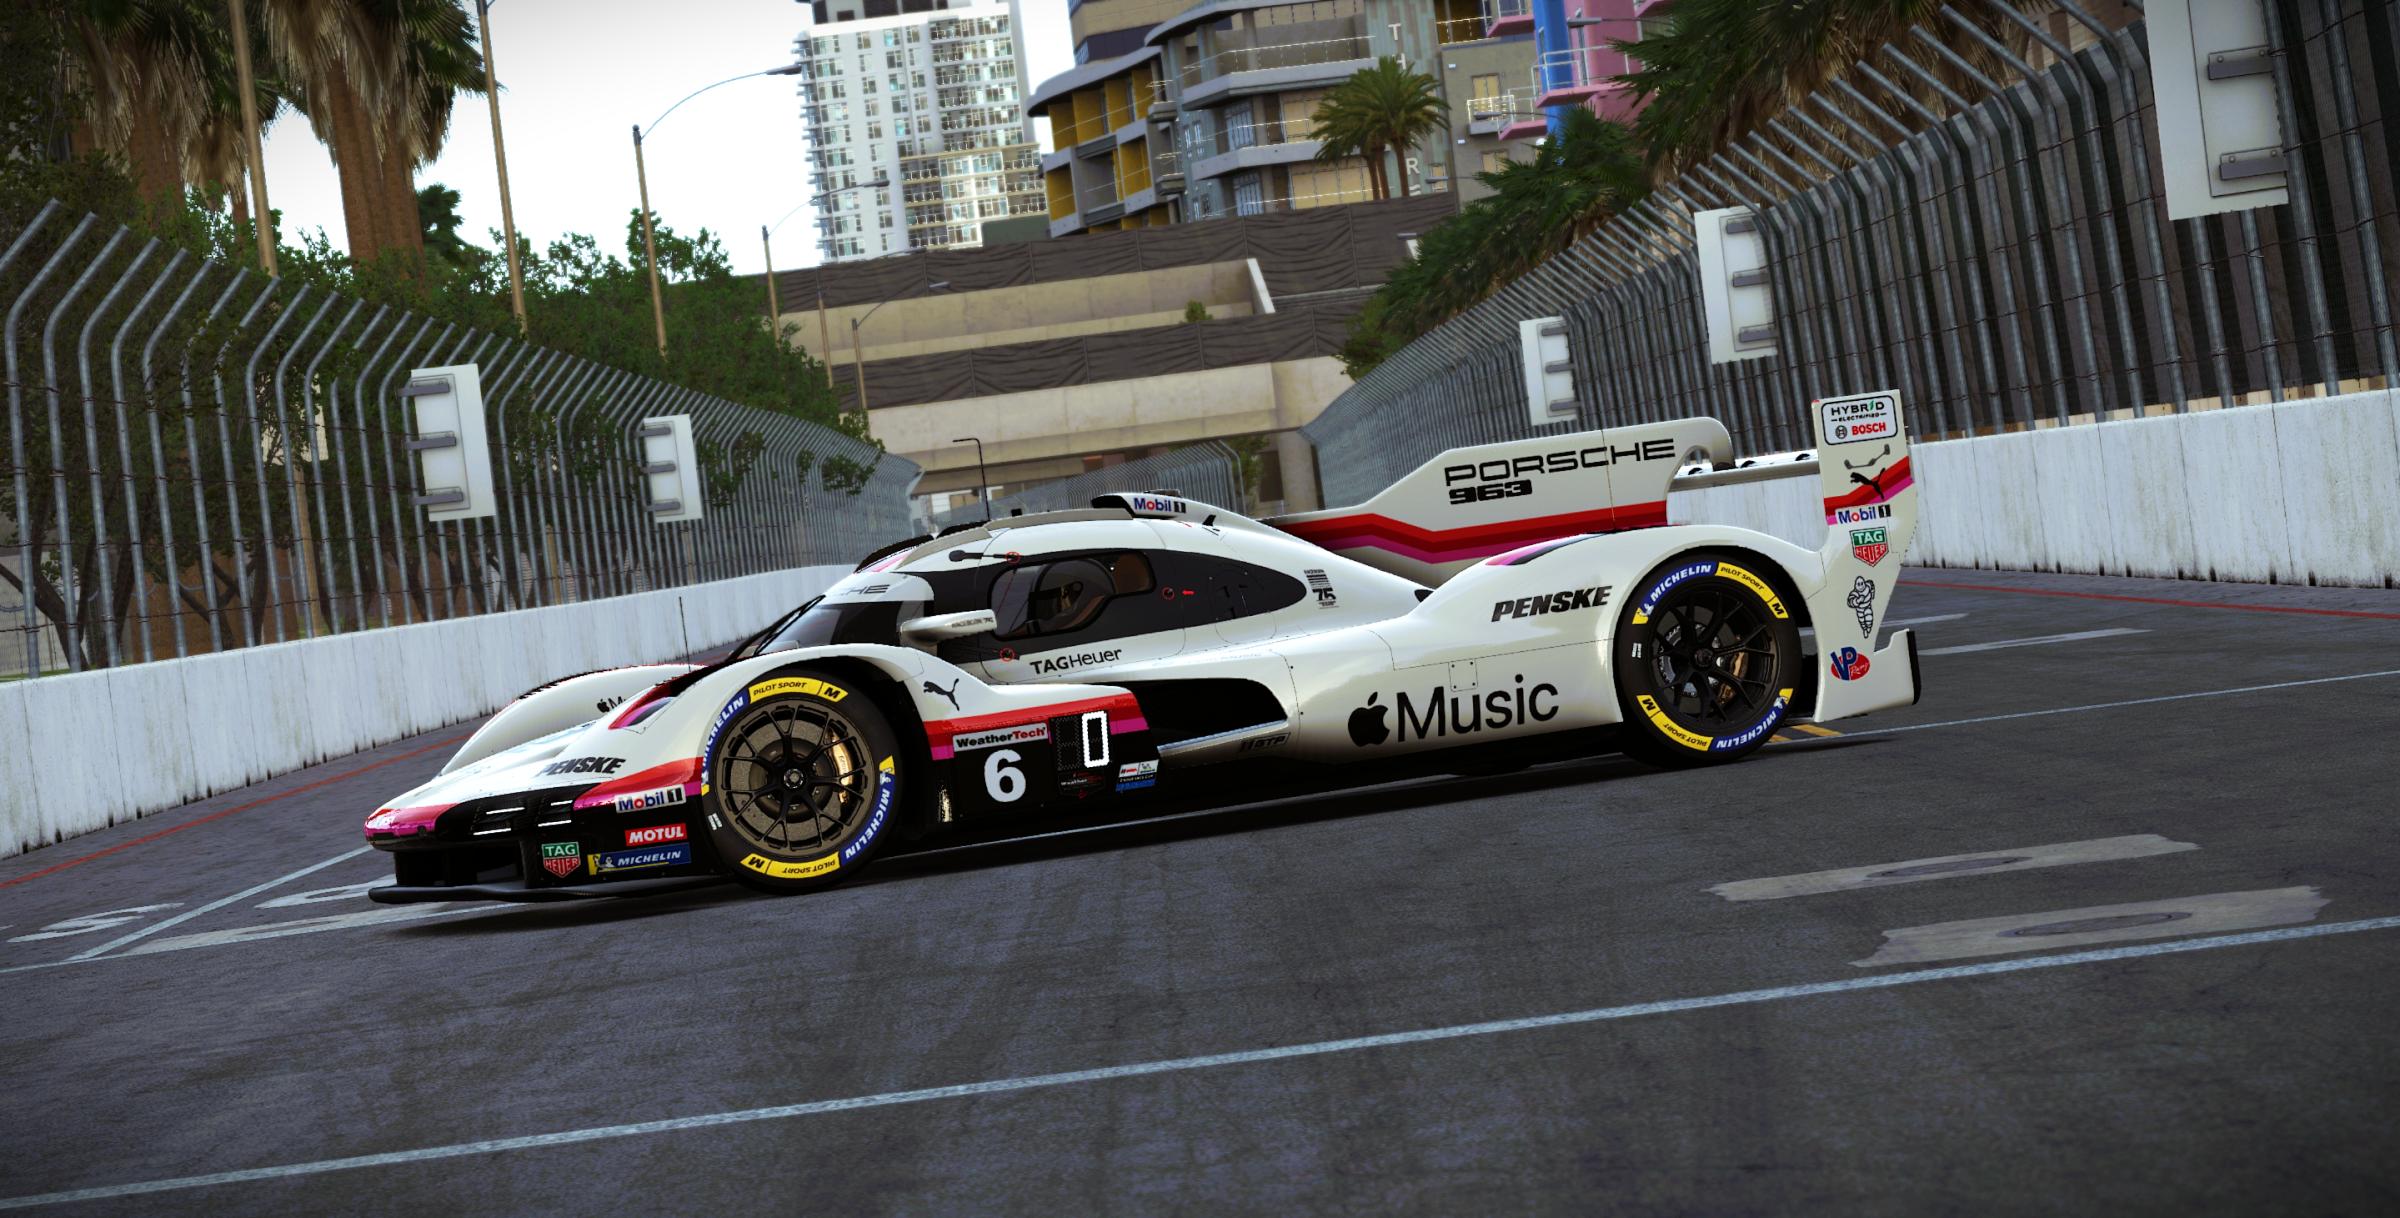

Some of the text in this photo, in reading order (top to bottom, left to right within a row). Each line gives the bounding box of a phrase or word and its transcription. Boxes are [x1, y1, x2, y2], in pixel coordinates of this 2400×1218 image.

[1831, 400, 1885, 416] HYBRID
[1851, 422, 1887, 436] BOSCH
[1444, 438, 1676, 486] PORSCHE
[1449, 479, 1533, 505] 963
[1134, 497, 1172, 511] Mobil
[1838, 508, 1877, 524] Mobil
[1854, 532, 1884, 543] TAG
[1855, 545, 1888, 562] HEUER
[1650, 564, 1712, 602] MICHELIN
[1720, 566, 1765, 590] PILOT SPORT
[1491, 586, 1612, 622] PENSKE
[1771, 603, 1785, 615] M
[1830, 647, 1857, 681] VP
[753, 681, 807, 696] PILOT SPORT
[824, 687, 841, 699] M
[1396, 674, 1559, 742] Music
[956, 727, 1046, 748] WeatherTech
[1663, 723, 1708, 747] PILOT SPORT
[1716, 711, 1778, 749] MICHELIN
[984, 749, 1027, 803] 6
[618, 791, 665, 812] Mobil
[845, 788, 891, 859] MICHELIN
[629, 827, 684, 844] MOTUL
[545, 845, 576, 857] TAG
[617, 851, 682, 866] MICHELIN
[544, 858, 579, 876] HEUER
[782, 861, 836, 874] PILOT SPORT
